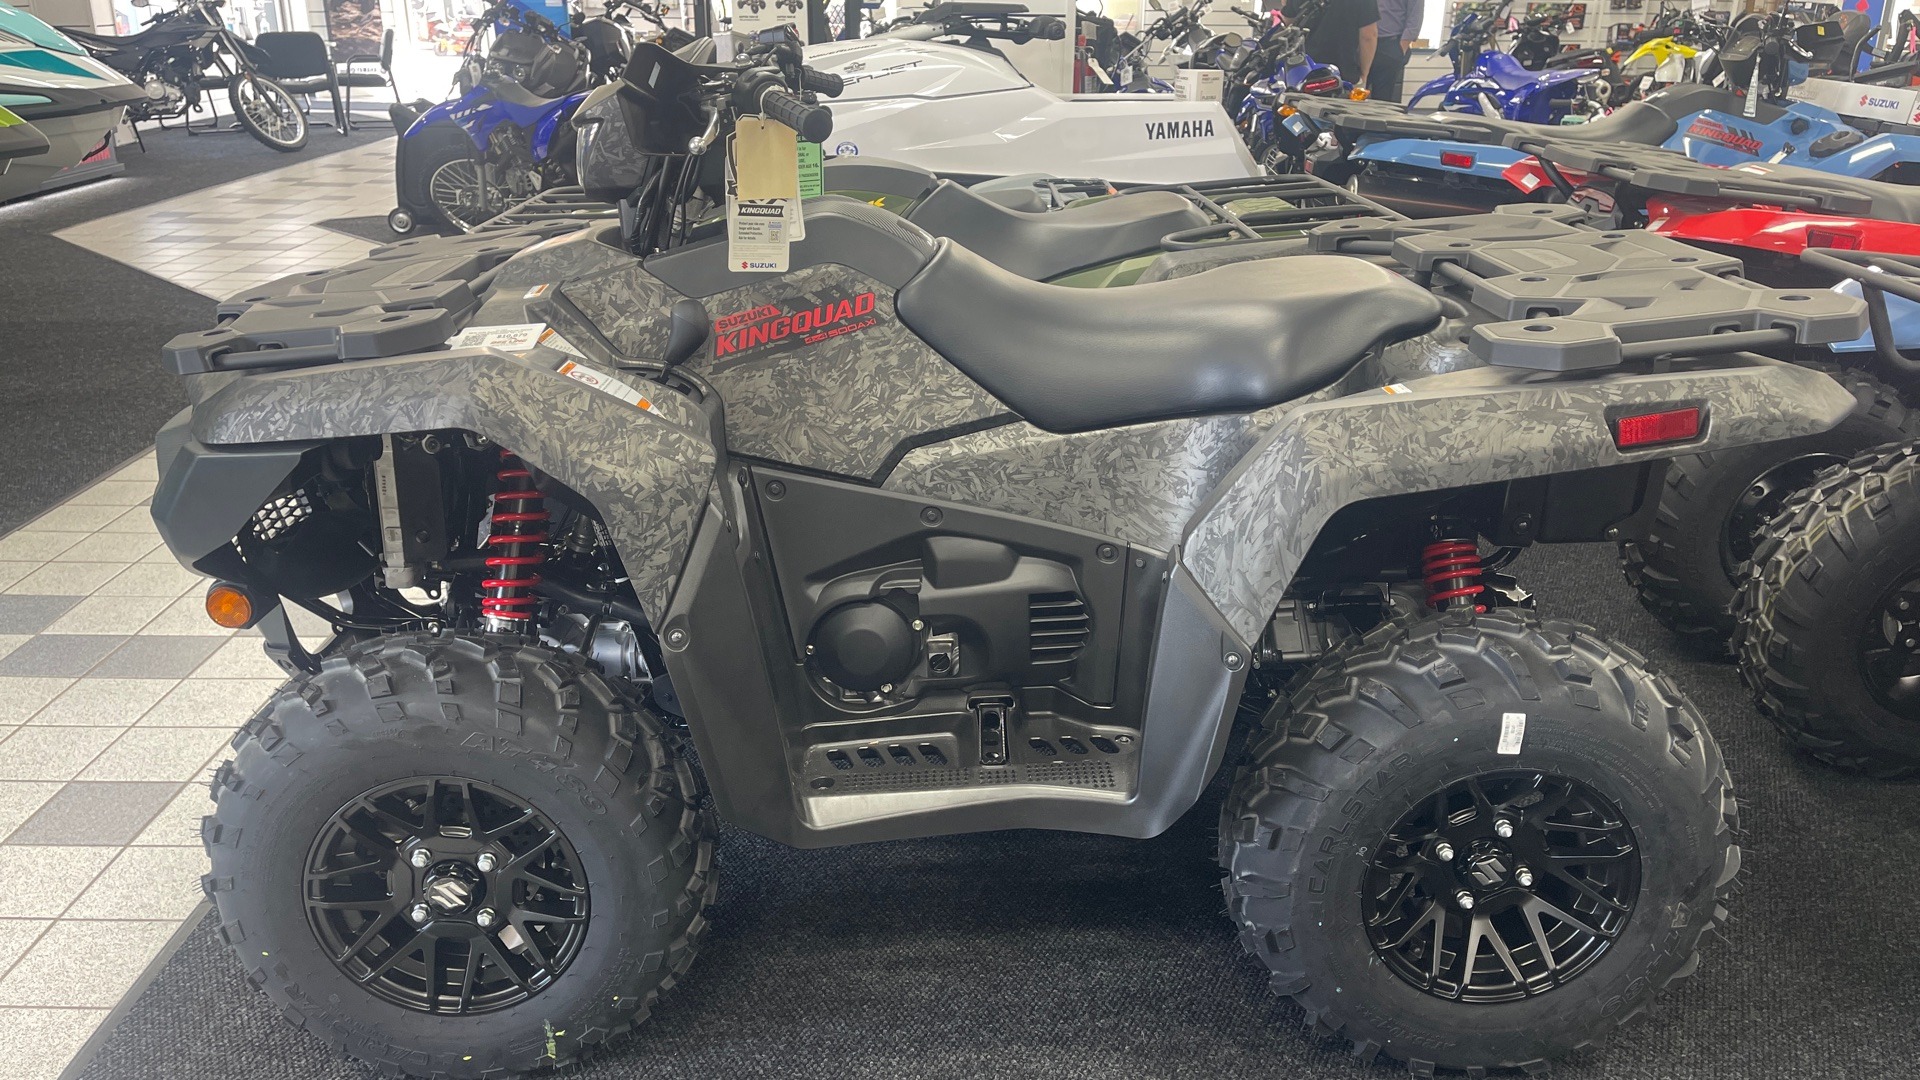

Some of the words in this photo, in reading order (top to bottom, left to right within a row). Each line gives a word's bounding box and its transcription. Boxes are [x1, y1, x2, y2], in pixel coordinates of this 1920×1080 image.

[1868, 97, 1900, 110] SUZUKI
[1145, 119, 1215, 140] YAMAHA
[1687, 124, 1764, 150] KINGQUAD
[741, 206, 782, 215] KINGQUAD
[715, 292, 876, 357] KINGQUAD
[717, 305, 774, 330] SUZUKI
[1308, 751, 1418, 896] CARLSTAR
